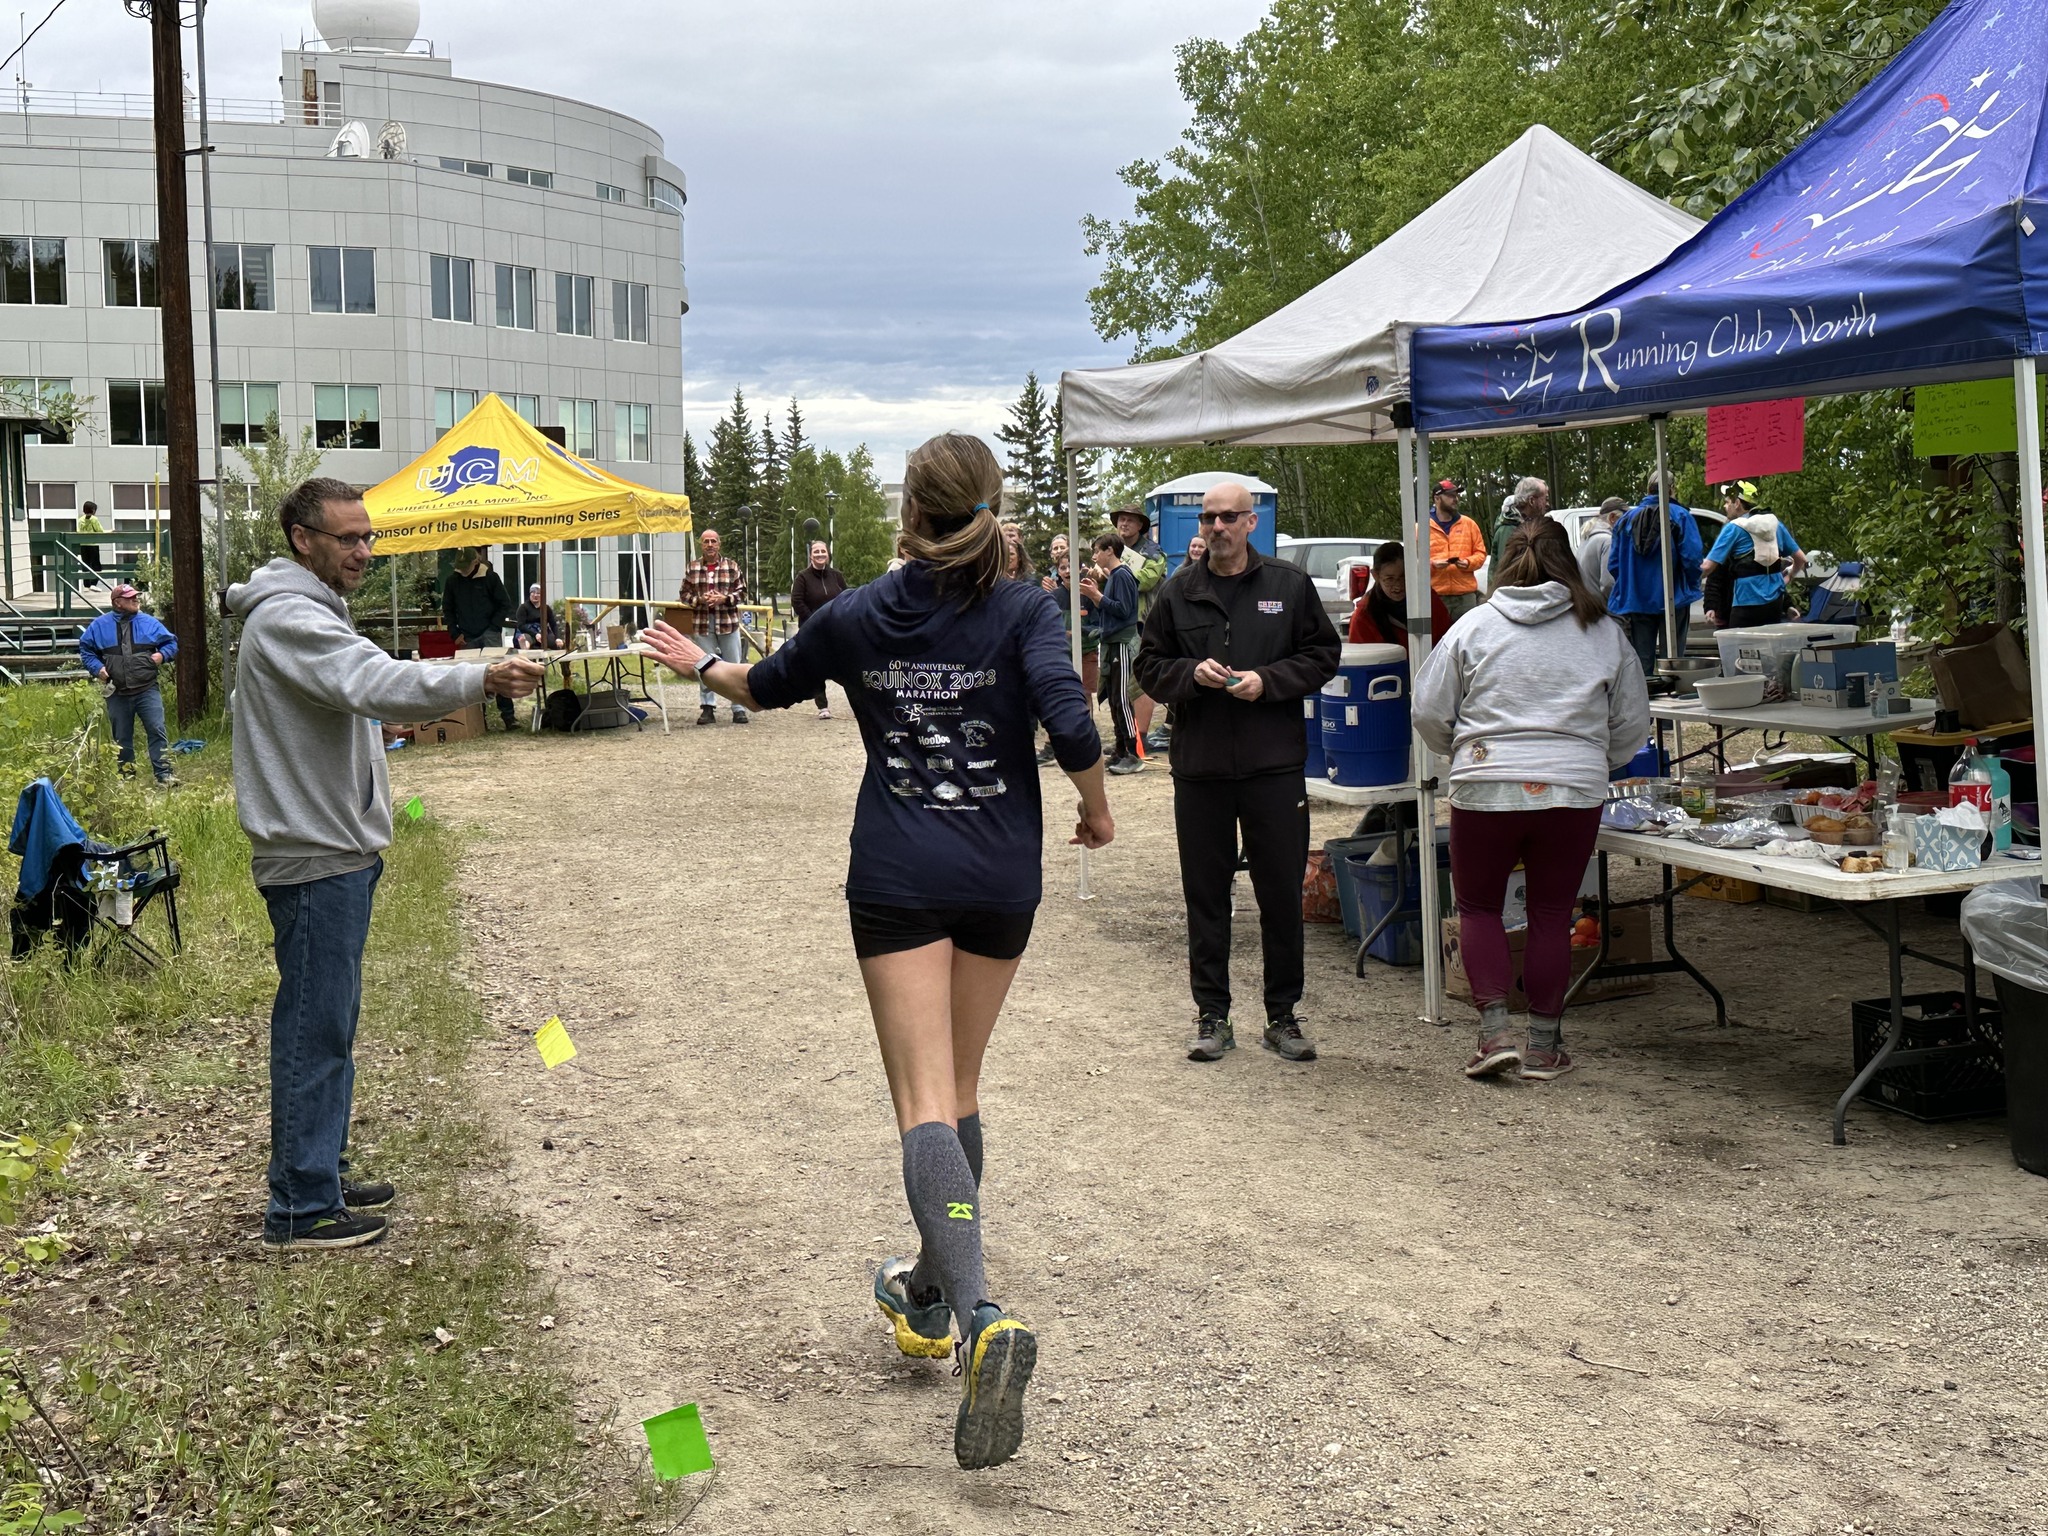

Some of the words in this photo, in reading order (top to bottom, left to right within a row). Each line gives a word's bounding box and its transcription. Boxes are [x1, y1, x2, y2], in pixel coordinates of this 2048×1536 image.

[1571, 307, 1698, 394] Running
[1707, 308, 1773, 359] Club
[1776, 292, 1878, 355] North
[416, 457, 540, 491] UCM
[447, 499, 480, 508] COAL
[419, 522, 434, 534] of
[436, 521, 458, 532] the
[462, 516, 512, 530] Usibelli
[517, 512, 574, 528] Running
[578, 509, 621, 522] Series
[911, 663, 966, 671] ANNIVERSARY
[949, 668, 997, 690] 2023
[896, 690, 959, 699] MARATHON
